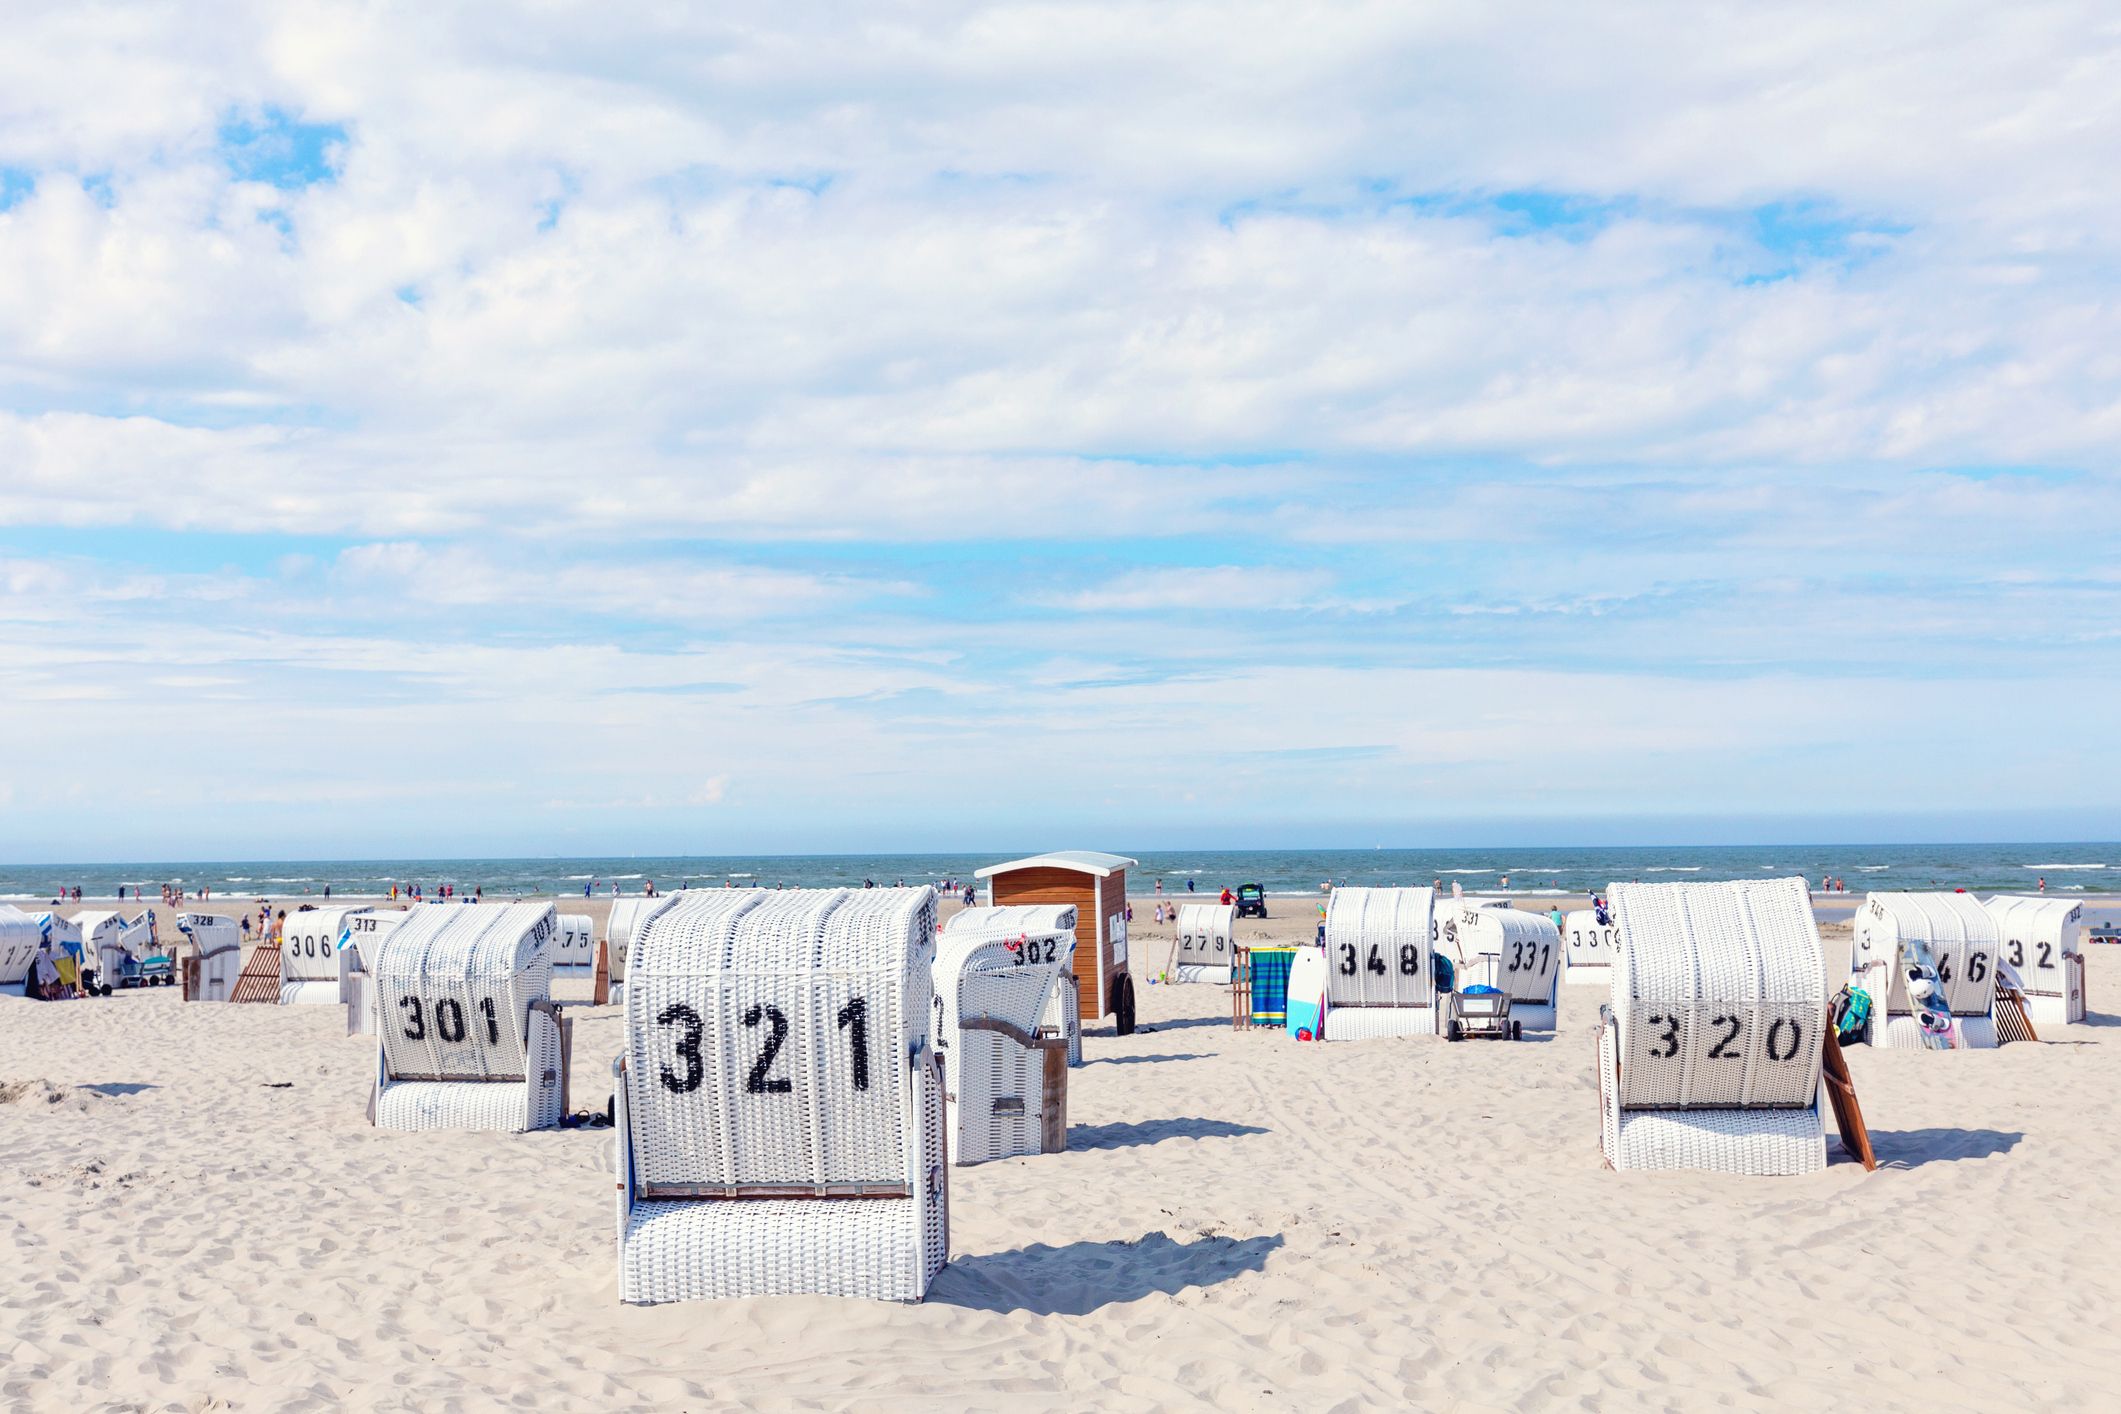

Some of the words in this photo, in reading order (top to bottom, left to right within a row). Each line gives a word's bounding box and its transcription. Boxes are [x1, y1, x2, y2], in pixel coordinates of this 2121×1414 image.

[193, 915, 213, 926] 328
[354, 917, 376, 932] 313
[1461, 910, 1479, 925] 331
[291, 934, 331, 958] 306
[1012, 938, 1056, 966] 302
[1183, 935, 1224, 951] 279
[1340, 943, 1418, 976] 348
[1508, 941, 1550, 976] 331
[400, 995, 498, 1045] 301
[656, 997, 870, 1093] 321
[1648, 1013, 1801, 1061] 320
